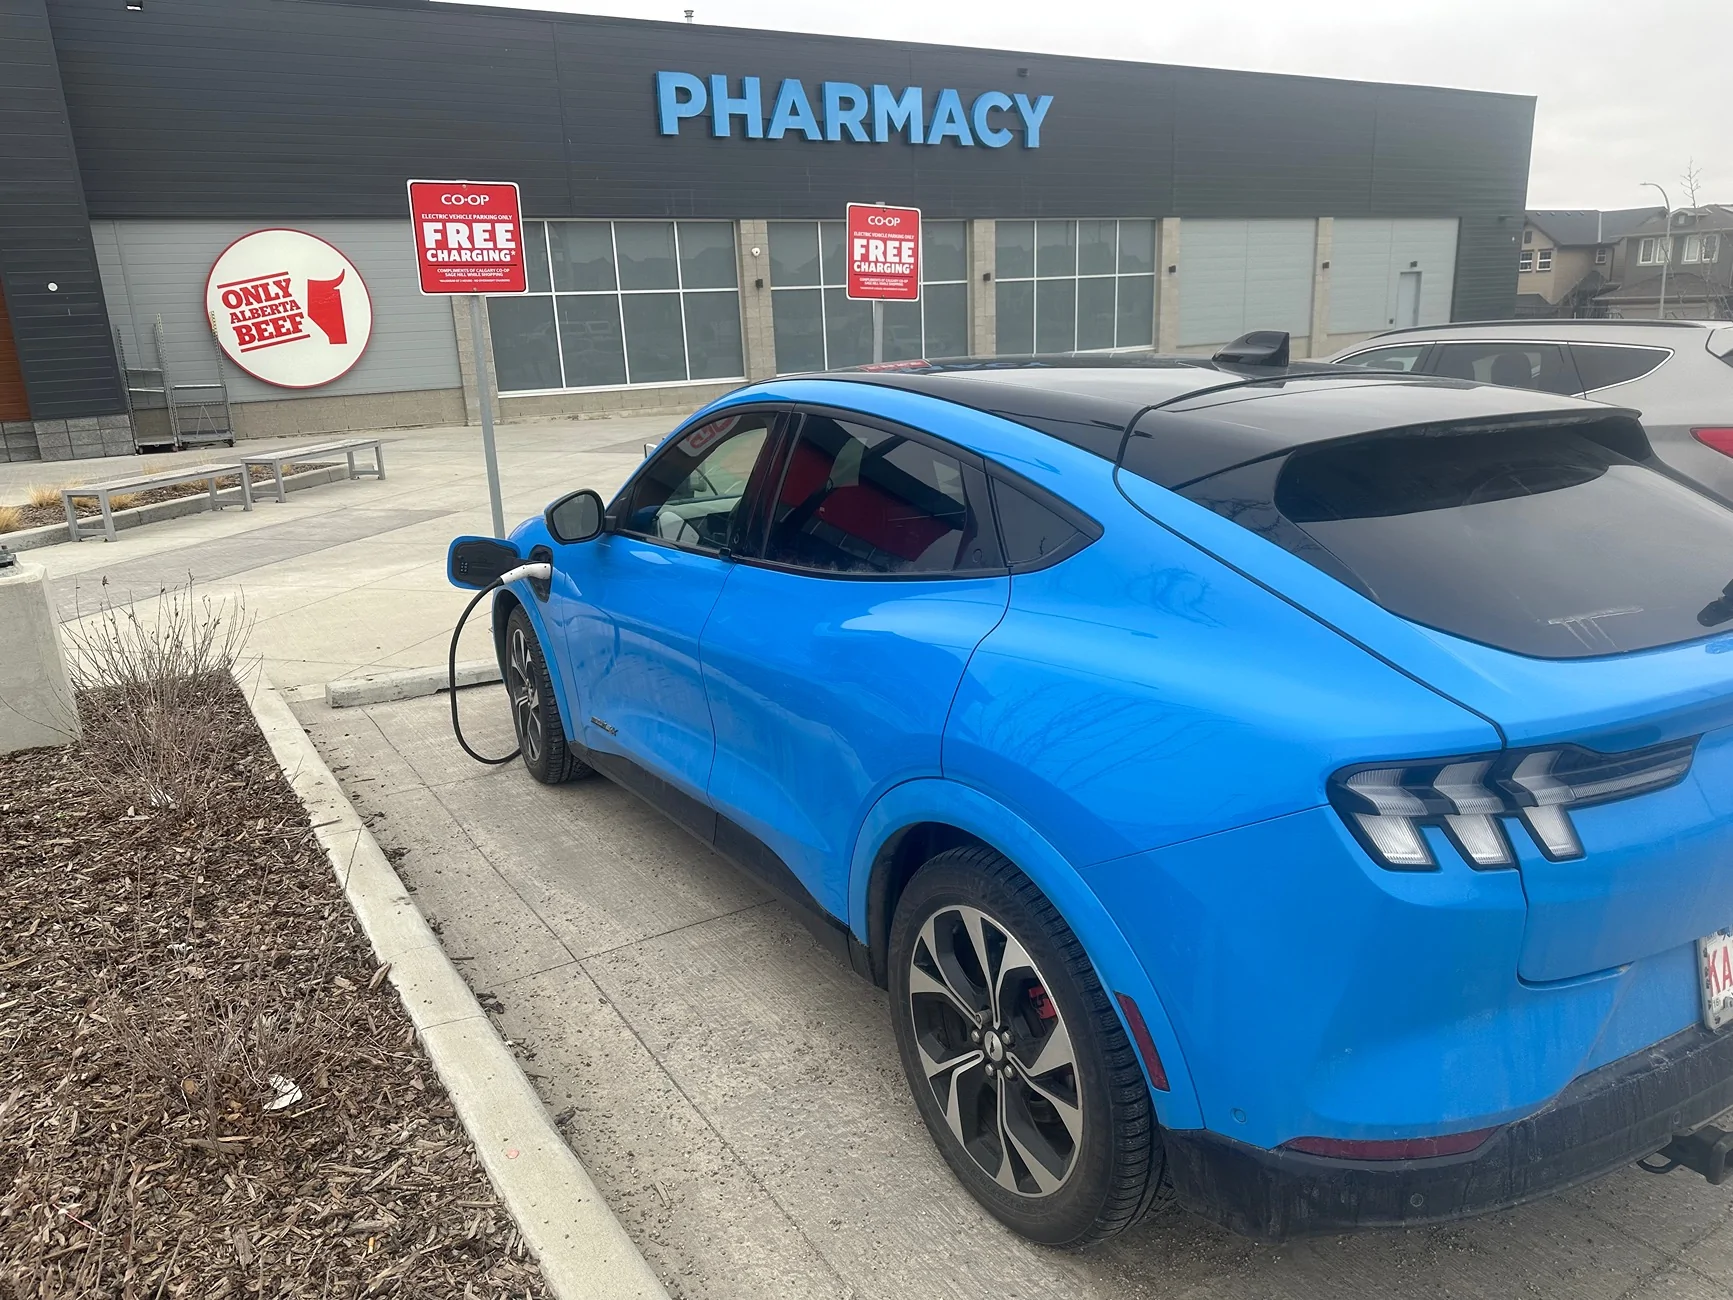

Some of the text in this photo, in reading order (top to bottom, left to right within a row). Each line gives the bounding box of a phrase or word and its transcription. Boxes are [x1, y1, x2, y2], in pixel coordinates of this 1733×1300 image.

[656, 70, 1054, 148] PHARMACY
[422, 222, 516, 249] FREE
[853, 238, 915, 263] FREE
[222, 277, 292, 309] ONLY
[229, 299, 301, 324] ALBERTA
[232, 312, 304, 346] BEEF
